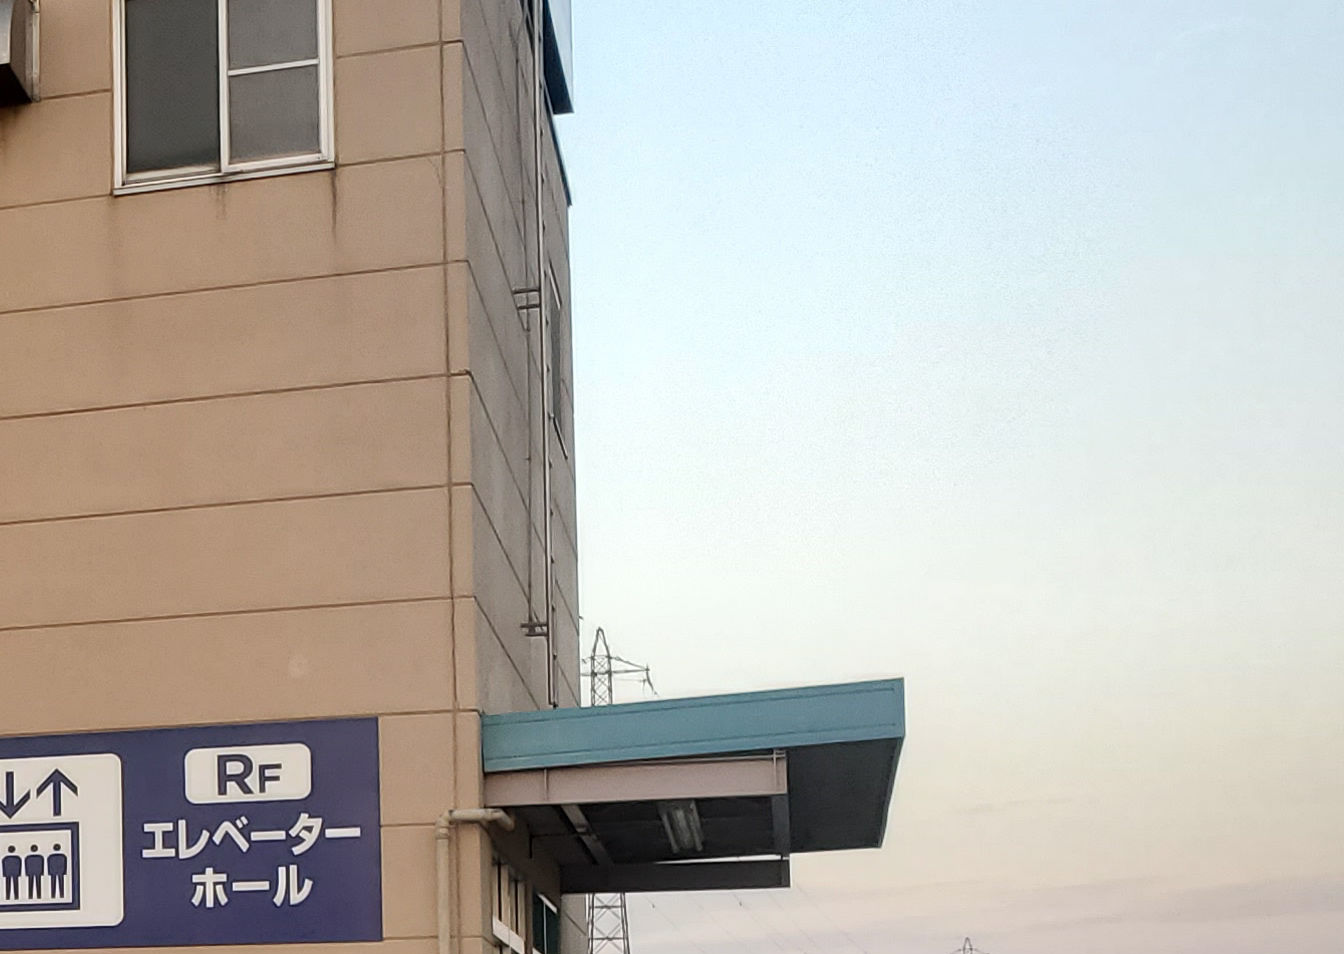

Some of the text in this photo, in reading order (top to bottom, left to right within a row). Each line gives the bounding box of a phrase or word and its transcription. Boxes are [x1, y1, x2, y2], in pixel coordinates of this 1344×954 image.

[216, 753, 283, 796] RF
[141, 812, 362, 860] エレベーター
[190, 864, 314, 908] ホール
